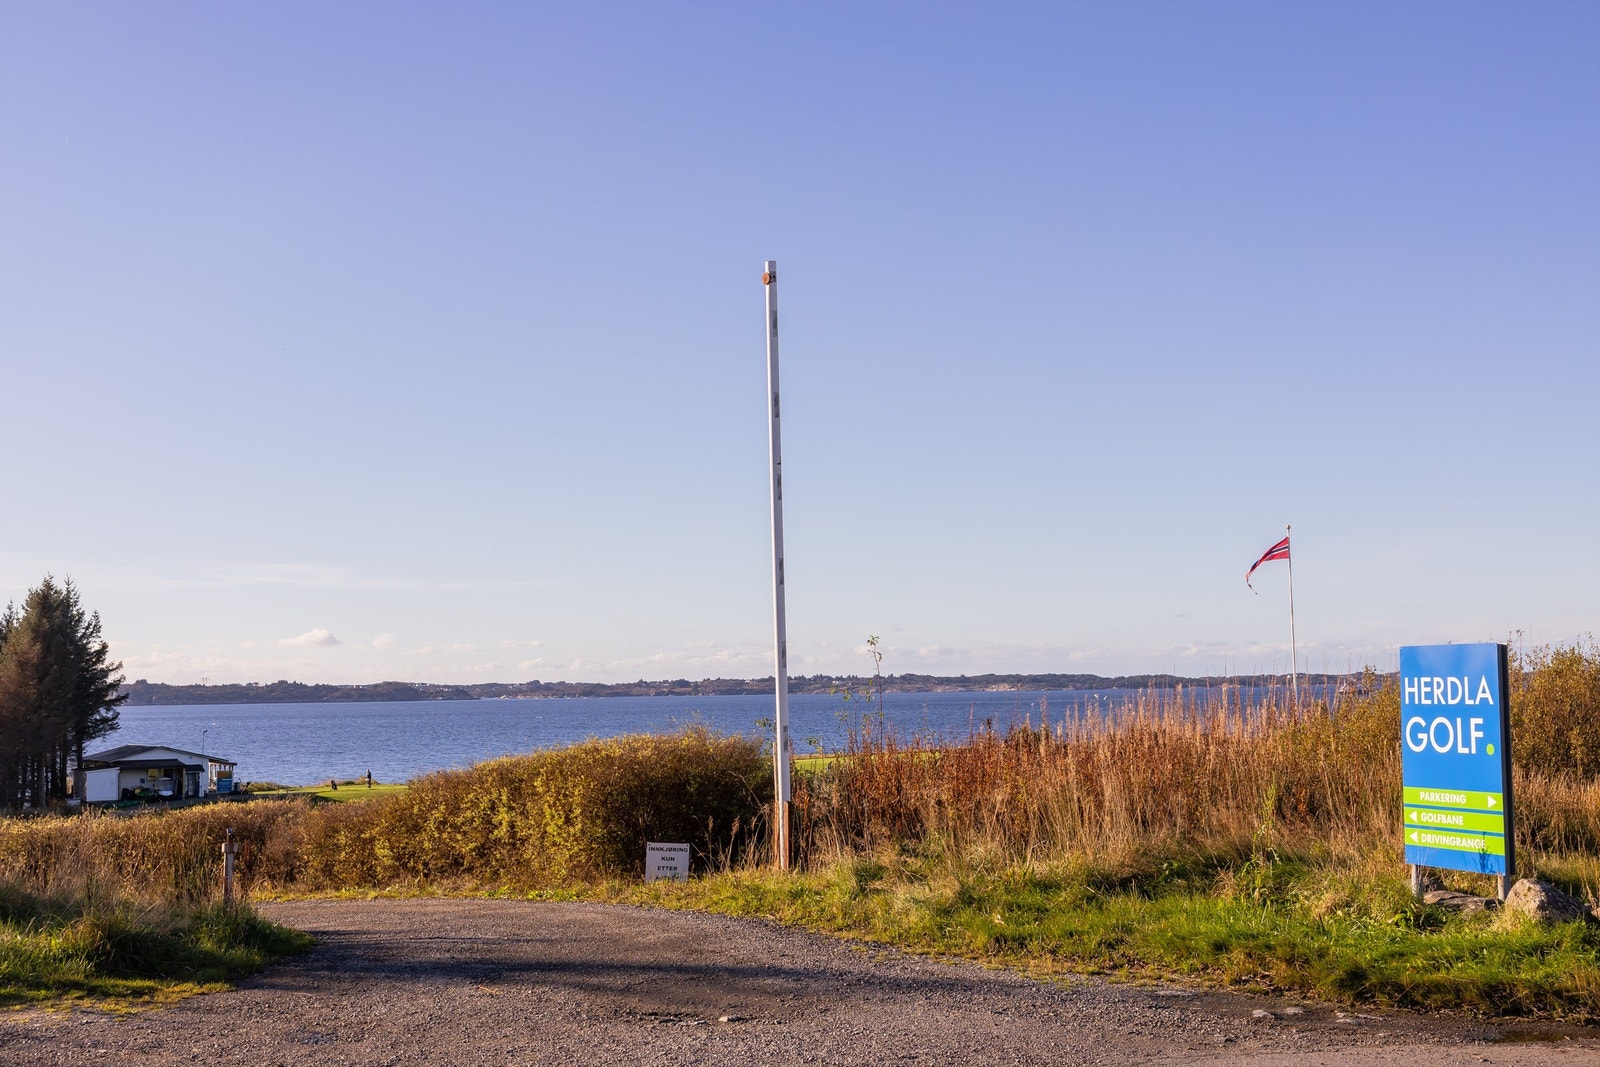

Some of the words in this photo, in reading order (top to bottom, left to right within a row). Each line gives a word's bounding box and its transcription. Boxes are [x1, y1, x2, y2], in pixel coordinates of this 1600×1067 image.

[1404, 675, 1494, 705] HERDLA
[1420, 791, 1467, 804] PARKERING
[1420, 812, 1464, 826] GOLFBANE
[1421, 833, 1486, 849] DRIVINGRANGE
